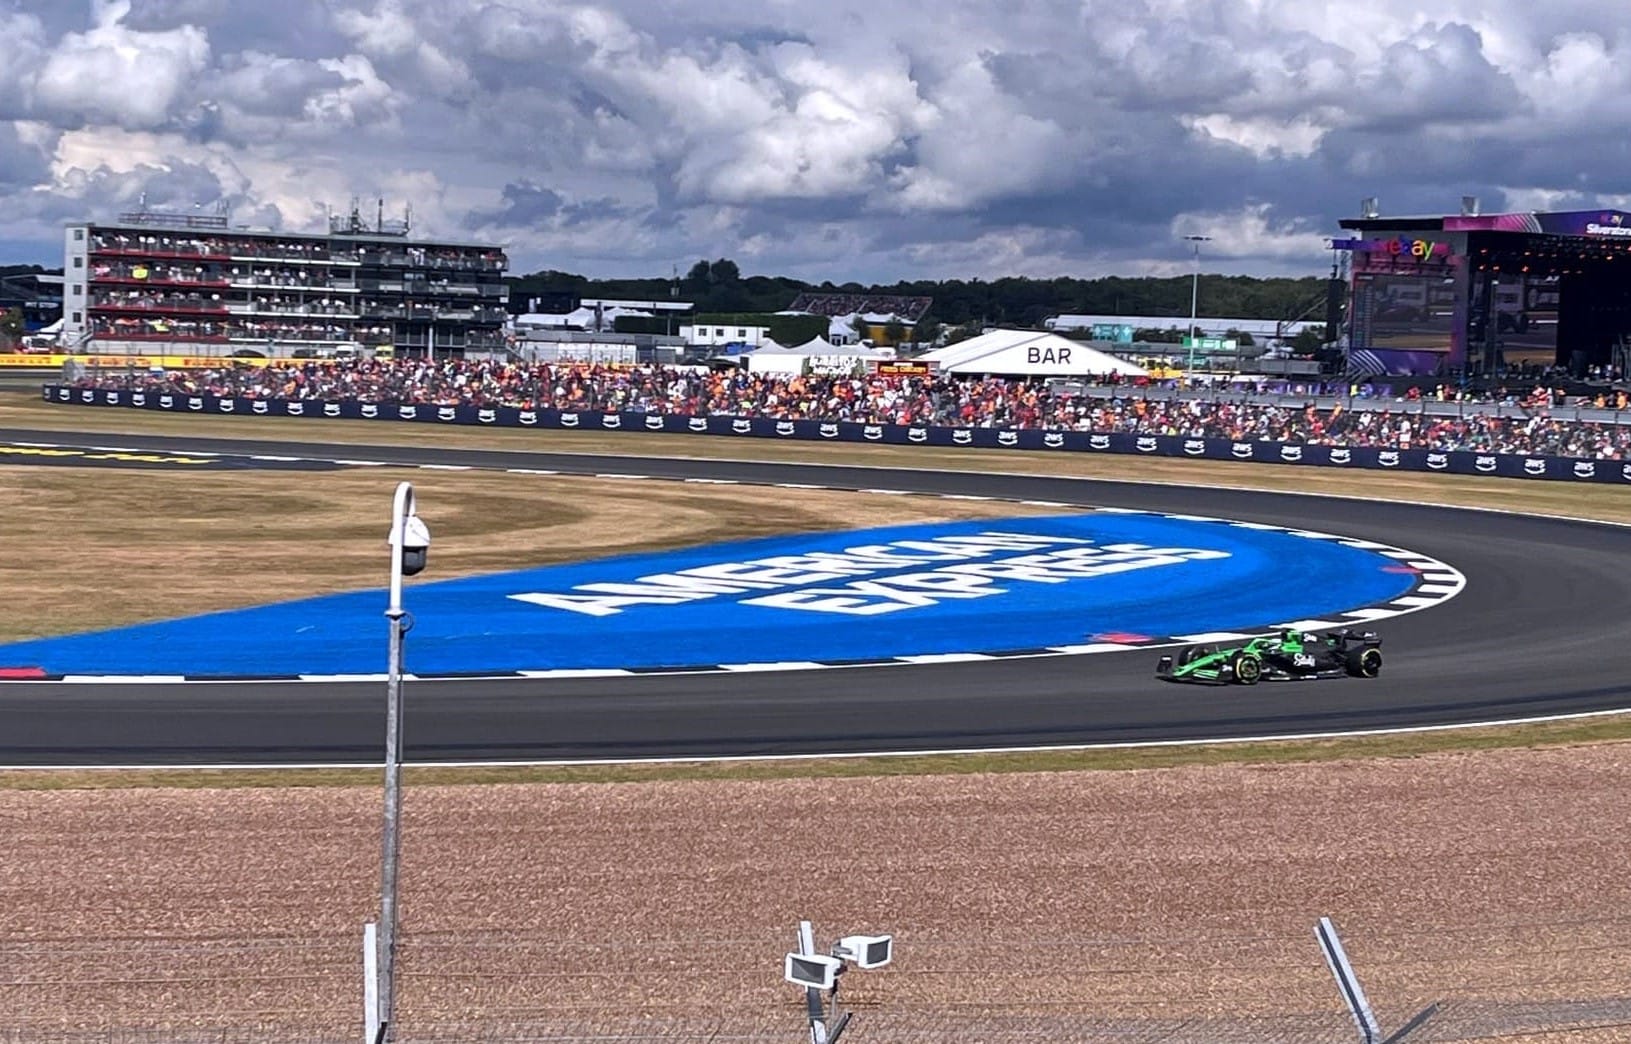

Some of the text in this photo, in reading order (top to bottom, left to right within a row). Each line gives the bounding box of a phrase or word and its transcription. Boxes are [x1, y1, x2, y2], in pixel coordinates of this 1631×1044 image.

[1388, 235, 1434, 262] ebay
[1028, 347, 1071, 364] BAR
[1281, 446, 1302, 456] aws
[1330, 449, 1350, 459] aws
[1379, 452, 1399, 462] aws
[1427, 454, 1447, 464] aws
[1476, 456, 1496, 467] aws
[1525, 459, 1545, 470] aws
[1574, 462, 1594, 473] aws
[505, 532, 1095, 616] AMERICAN
[737, 544, 1232, 615] EXPRESS
